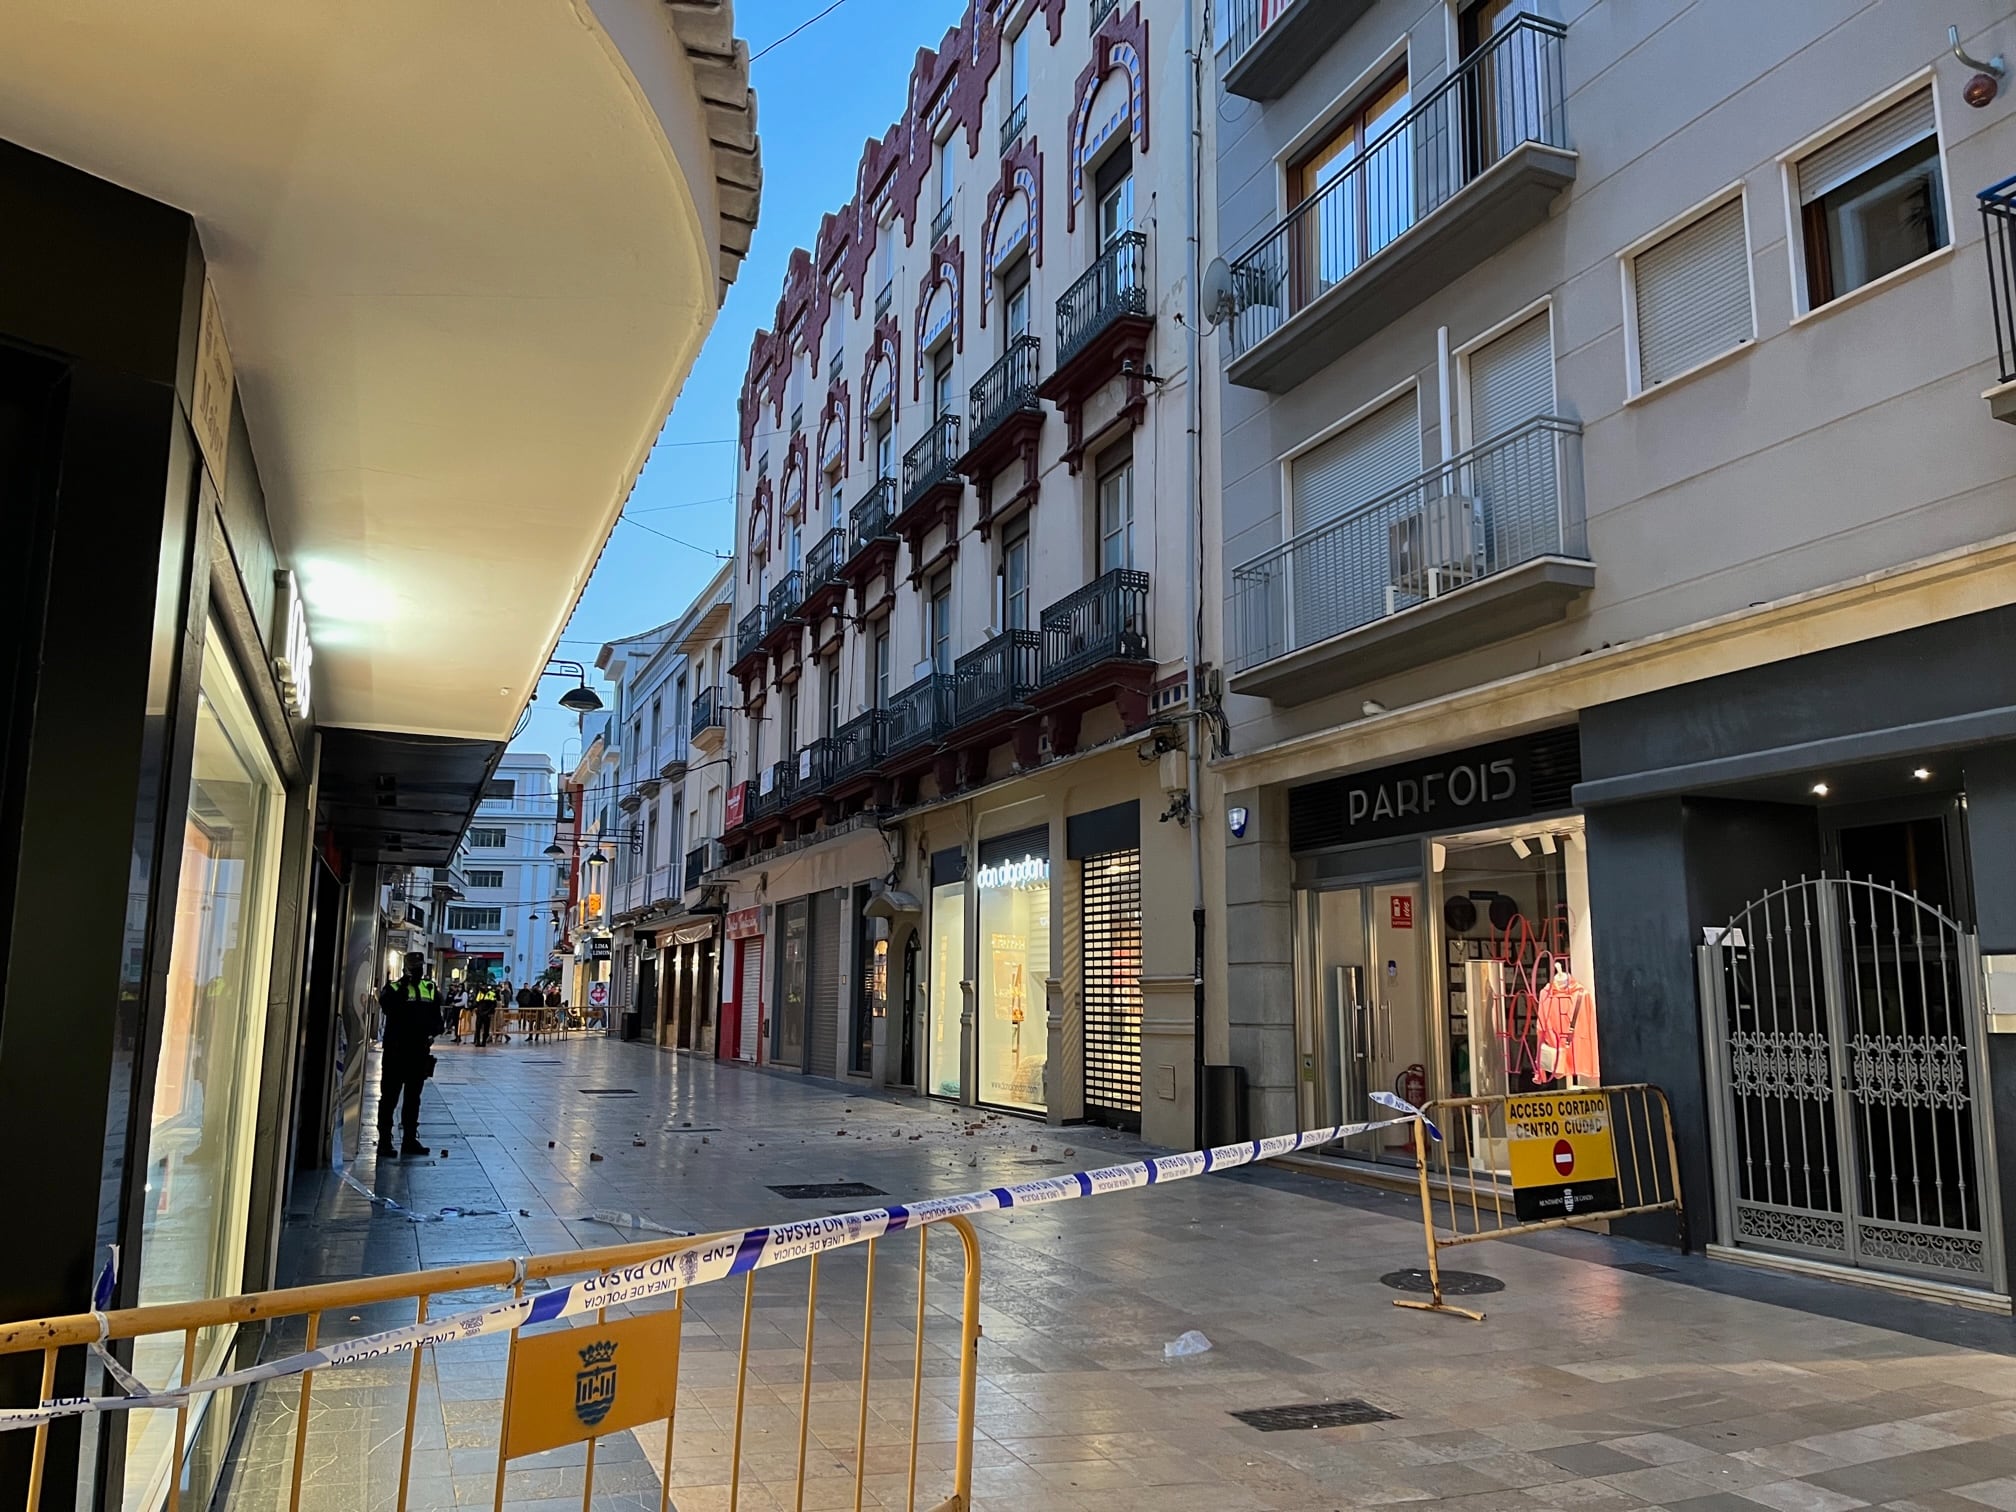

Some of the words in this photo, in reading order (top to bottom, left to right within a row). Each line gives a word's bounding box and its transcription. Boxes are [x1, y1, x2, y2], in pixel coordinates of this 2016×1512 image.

[1349, 758, 1516, 825] PARFOIS
[1491, 913, 1571, 965] LOVE
[1510, 1102, 1553, 1119] ACCESO
[1558, 1099, 1604, 1116] CORTADO
[1516, 1121, 1559, 1138] CENTRO
[1564, 1118, 1602, 1135] CIUDAD
[1159, 1157, 1178, 1170] PASAR
[920, 1207, 947, 1221] POLICIA
[774, 1222, 820, 1245] PASAR
[823, 1217, 844, 1233] NO
[809, 1240, 820, 1252] DE
[822, 1233, 845, 1249] LINEA
[703, 1244, 735, 1263] CNP
[774, 1243, 807, 1260] POLICIA
[650, 1254, 676, 1276] NO
[584, 1264, 645, 1291] PASAR
[647, 1277, 677, 1295] LINEA
[584, 1288, 628, 1309] POLICIA
[631, 1285, 644, 1298] DE
[416, 1331, 456, 1349] LINEA
